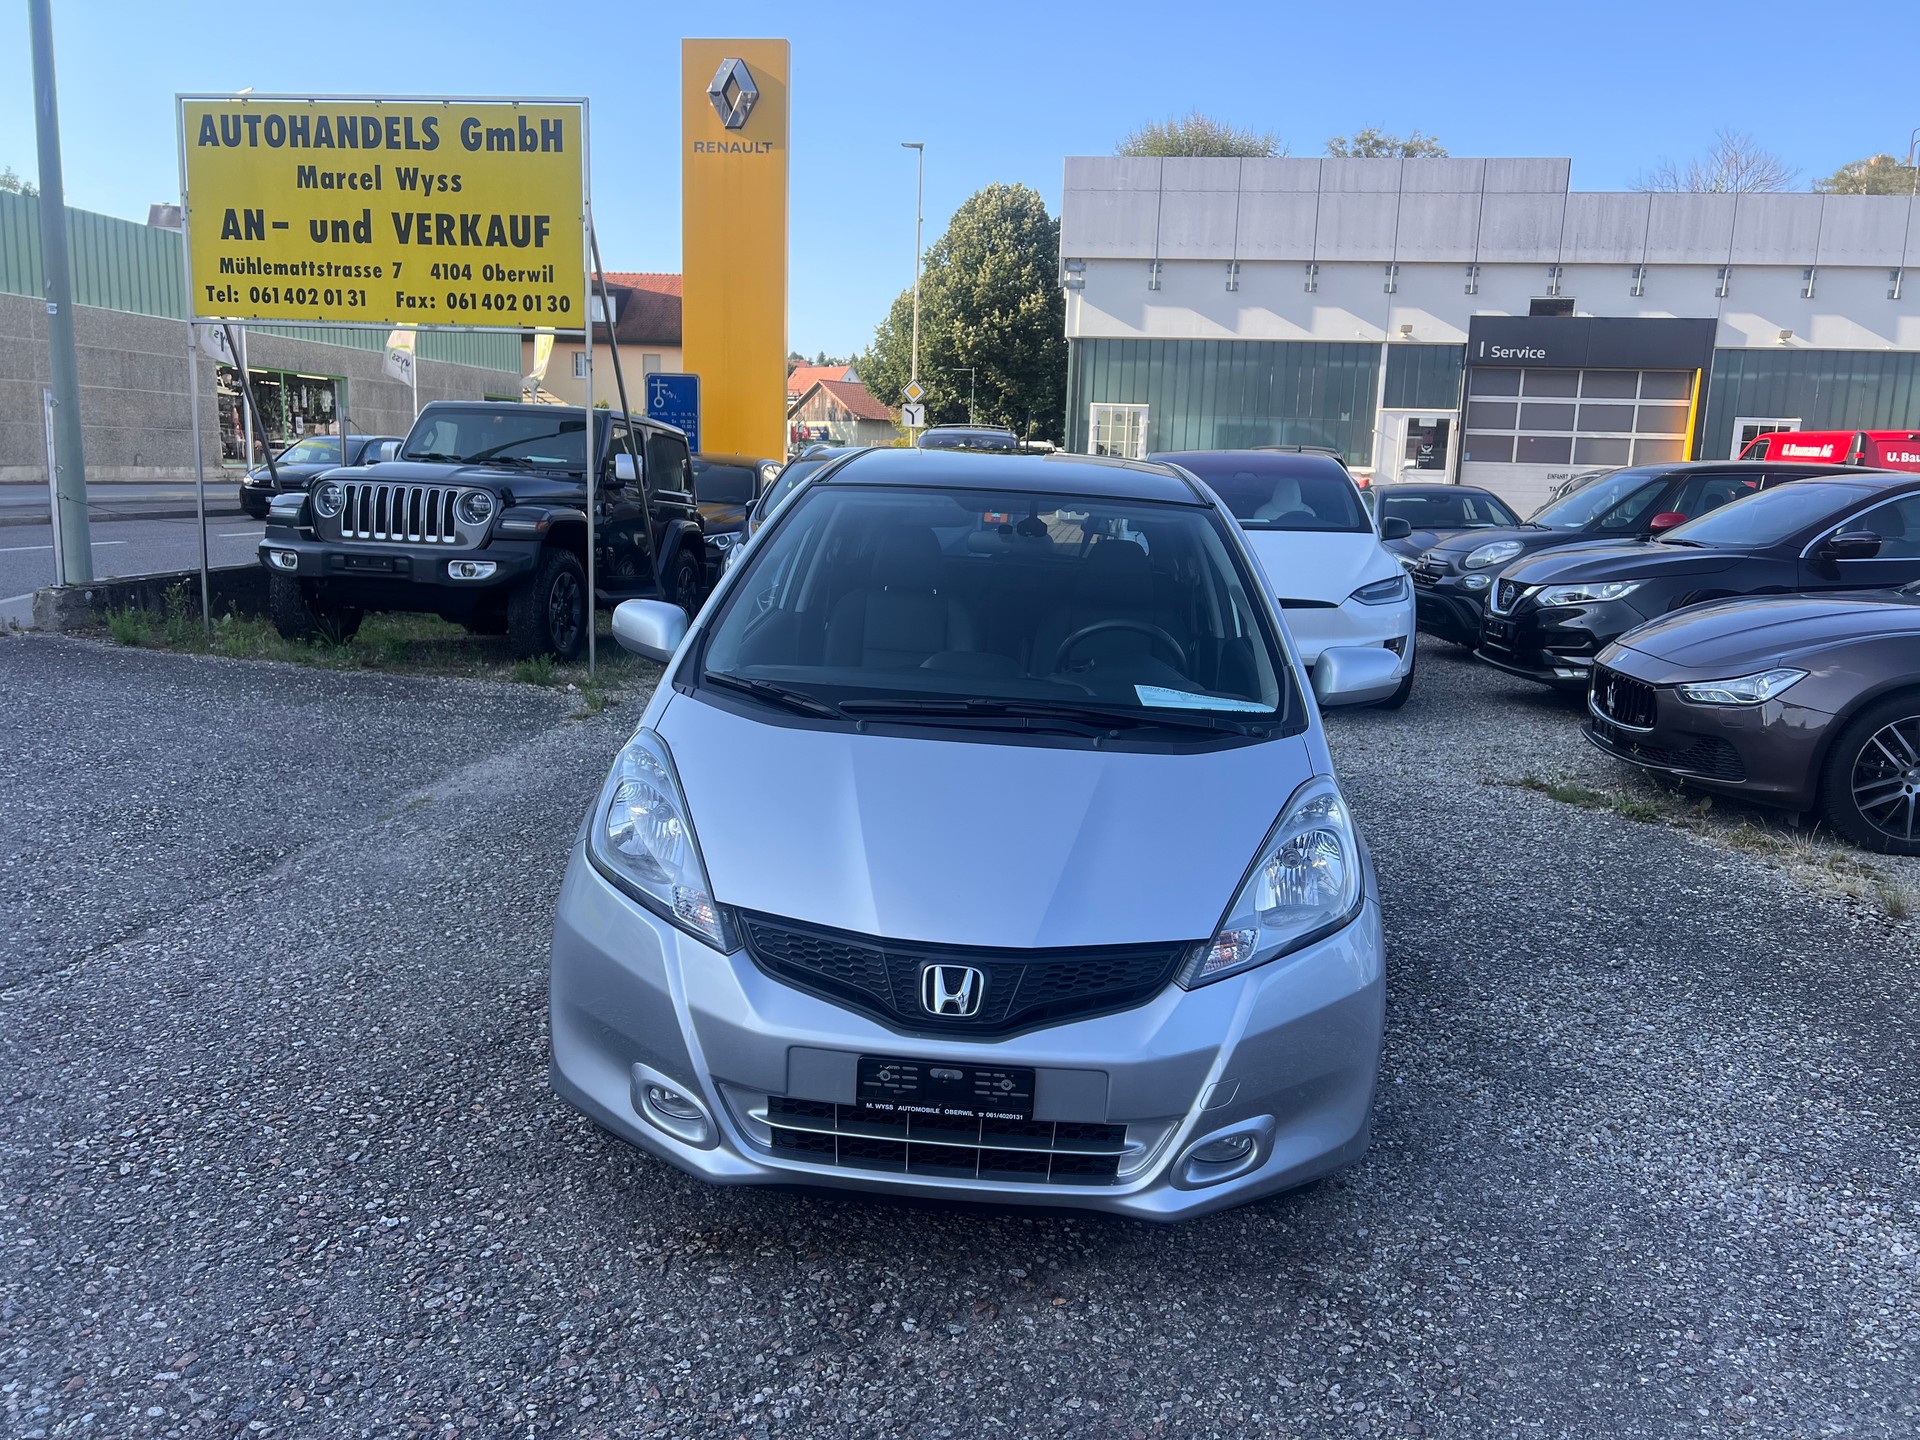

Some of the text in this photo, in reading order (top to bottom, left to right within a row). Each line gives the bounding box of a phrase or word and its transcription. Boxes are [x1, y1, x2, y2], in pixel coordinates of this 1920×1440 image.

[198, 114, 563, 153] AUTOHANDELS GmbH
[693, 141, 773, 153] RENAULT
[297, 164, 462, 197] Marcel Wyss
[309, 208, 372, 244] und
[391, 211, 550, 248] VERKAUF
[219, 257, 554, 283] Mühlemattstrasse 7 4104 Oberwil
[205, 284, 239, 303] Tel:
[395, 290, 436, 309] Fax:
[1490, 345, 1546, 359] Service
[874, 1103, 894, 1111] WYSS
[897, 1105, 941, 1114] AUTOMOBILE
[944, 1108, 974, 1117] OBERWIL
